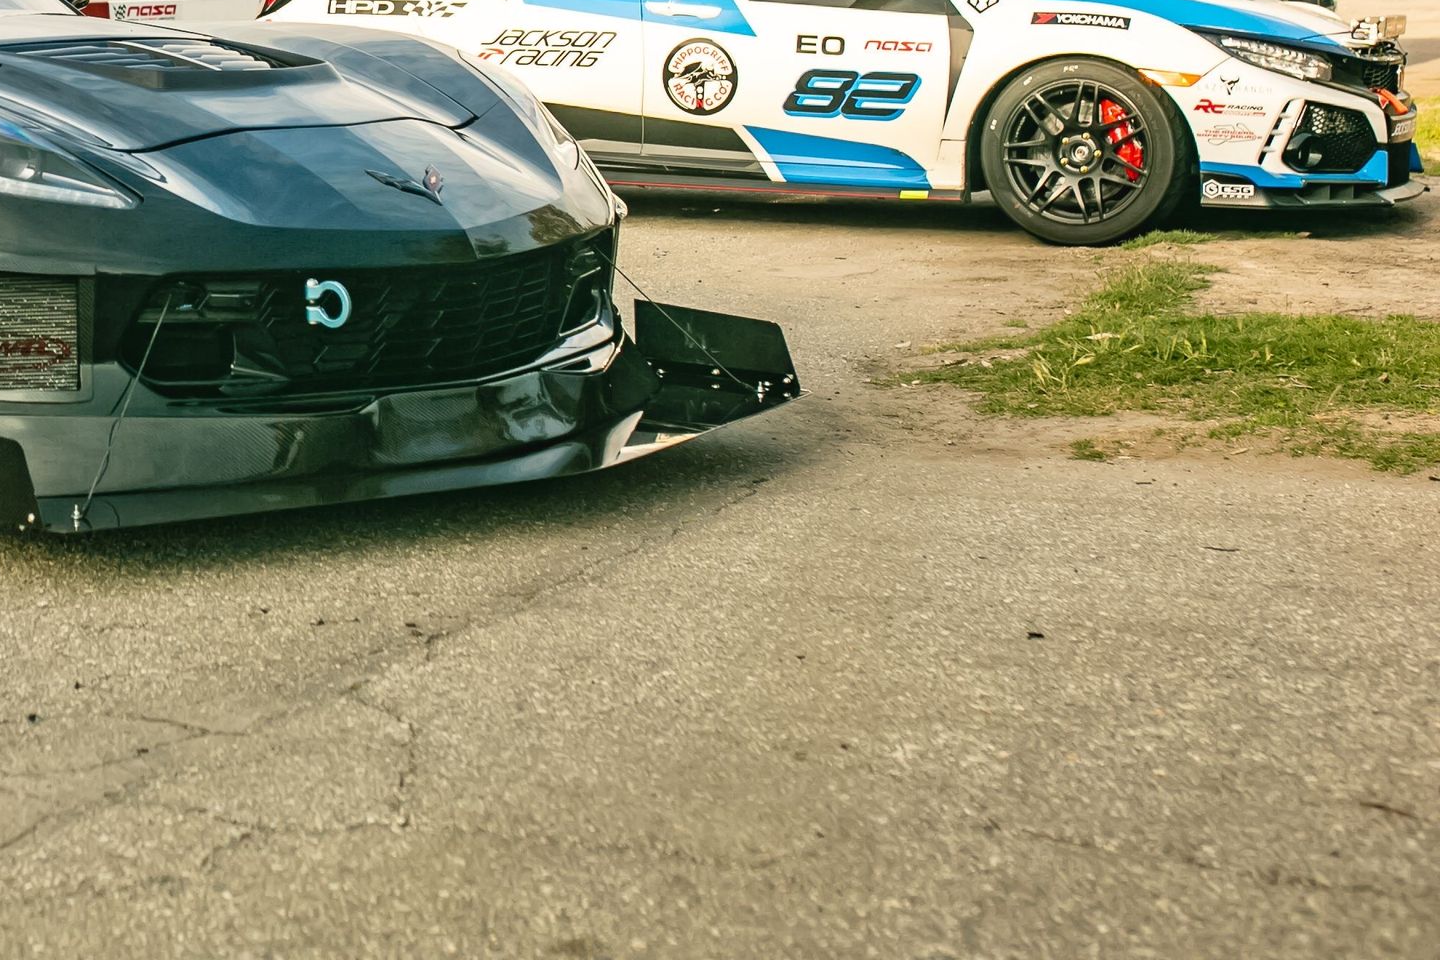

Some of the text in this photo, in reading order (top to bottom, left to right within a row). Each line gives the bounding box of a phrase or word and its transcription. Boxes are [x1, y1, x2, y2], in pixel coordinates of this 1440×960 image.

[329, 0, 395, 15] HPD
[1056, 13, 1125, 28] YOKOHAMA
[672, 46, 729, 71] HIPPOGRIFF
[782, 69, 922, 121] 82
